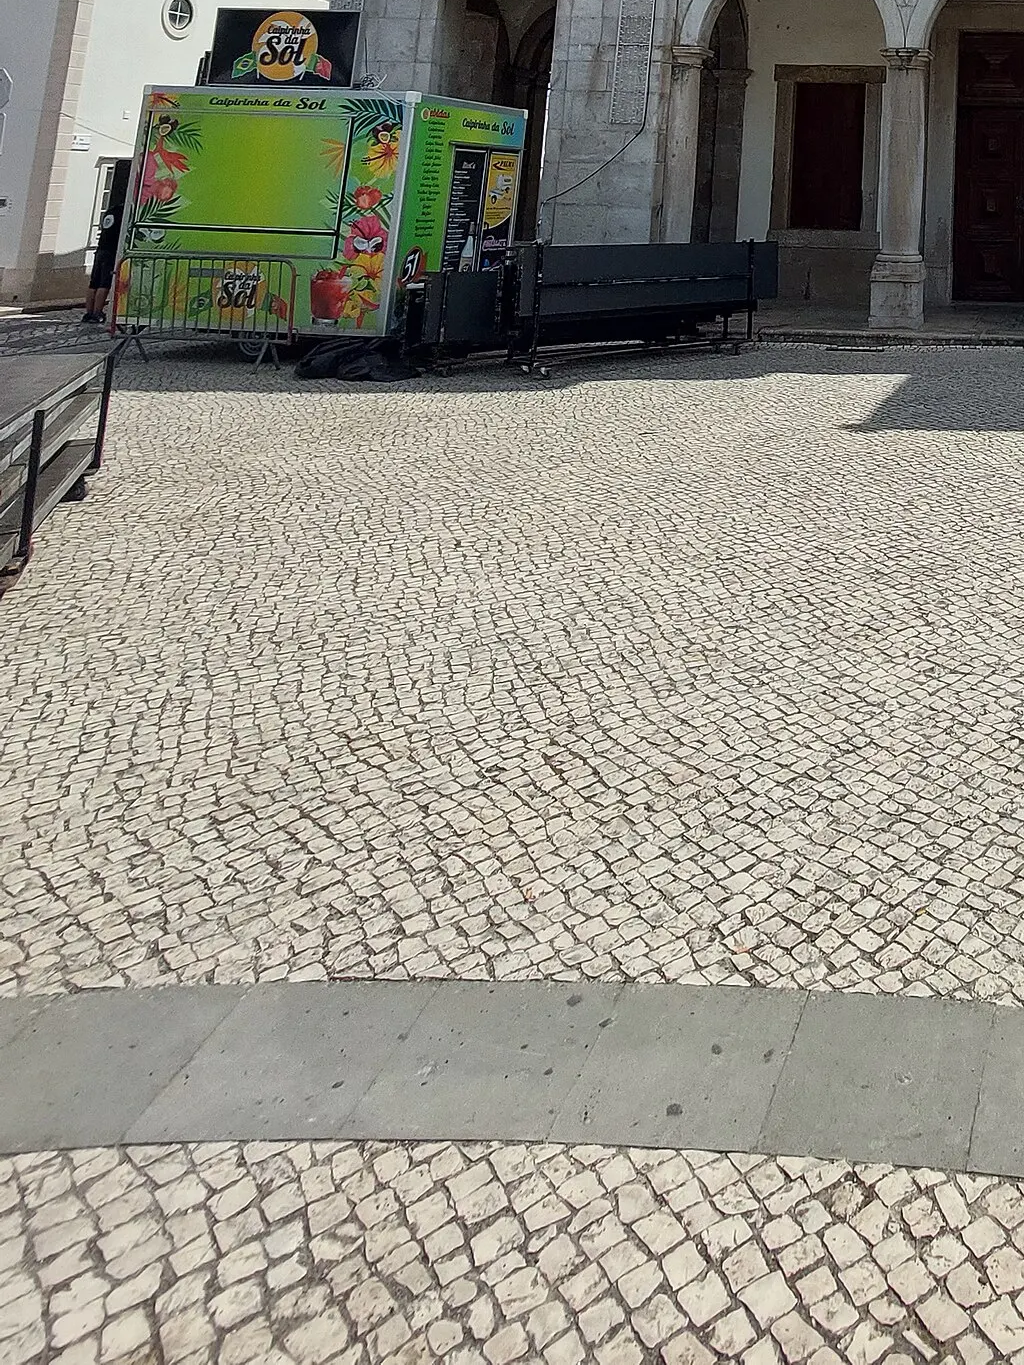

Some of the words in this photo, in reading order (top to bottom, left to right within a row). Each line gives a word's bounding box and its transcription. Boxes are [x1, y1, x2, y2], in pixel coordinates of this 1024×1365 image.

[267, 25, 311, 36] Caipirinha
[284, 35, 299, 45] da
[259, 35, 307, 66] Sol
[209, 97, 269, 107] Caipirinha
[273, 98, 292, 107] da
[295, 97, 327, 110] Sol
[462, 117, 491, 131] Caipirinha
[491, 122, 500, 132] da
[500, 121, 515, 136] Sol
[401, 251, 420, 283] 51
[217, 280, 258, 310] Sol
